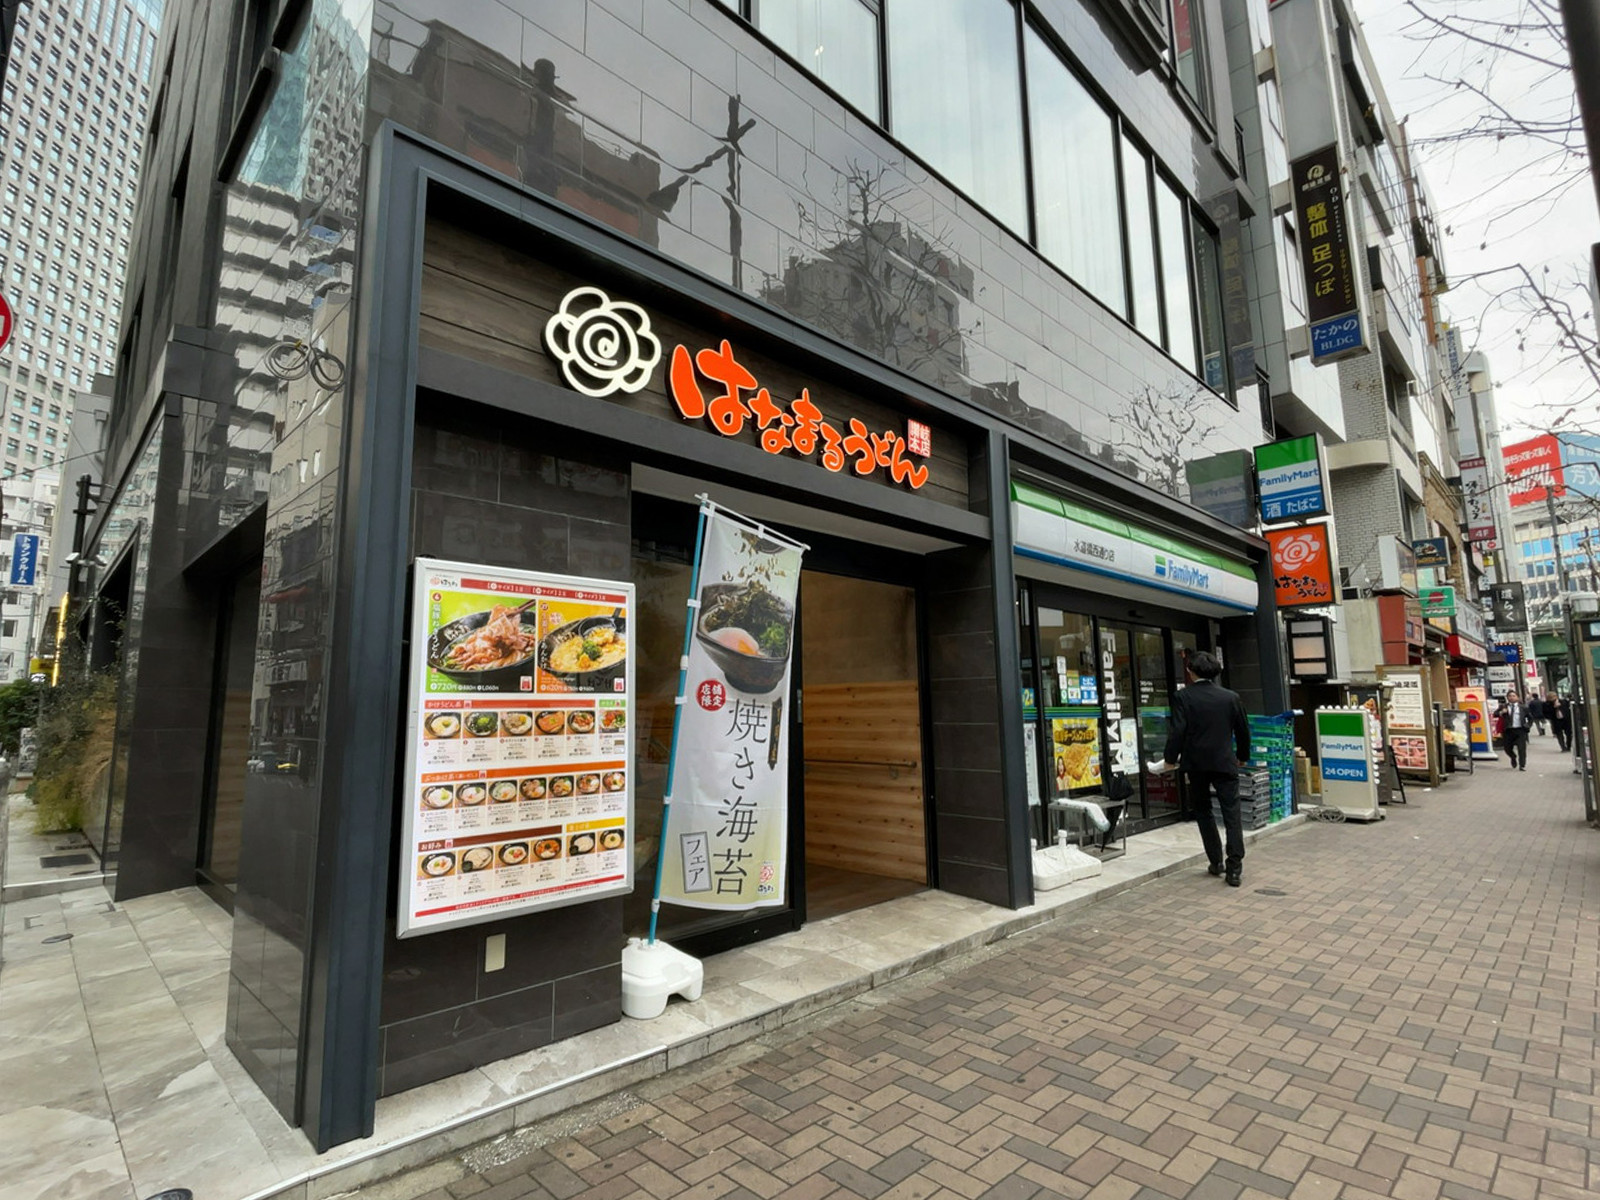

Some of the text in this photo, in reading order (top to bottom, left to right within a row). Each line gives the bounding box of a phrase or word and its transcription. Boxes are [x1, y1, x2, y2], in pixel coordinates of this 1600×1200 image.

[1306, 202, 1329, 240] 整体
[1312, 242, 1335, 298] 足つぼ
[1314, 319, 1358, 340] たかの
[1321, 334, 1354, 351] BLDG
[670, 339, 929, 489] はなまるうどん
[1260, 468, 1320, 487] FamilyMart
[1266, 497, 1320, 518] 酒 たばこ
[17, 536, 31, 584] トランクルーム
[1073, 539, 1115, 562] 水道橋西通り店
[1168, 560, 1209, 589] FamilyMart
[1274, 574, 1317, 588] はなまる
[701, 683, 723, 696] 店舗
[701, 694, 723, 708] 限定
[1321, 742, 1363, 751] FamilyMart
[1325, 767, 1364, 778] 24 OPEN
[714, 697, 768, 896] 焼き海苔
[686, 838, 704, 888] フェア
